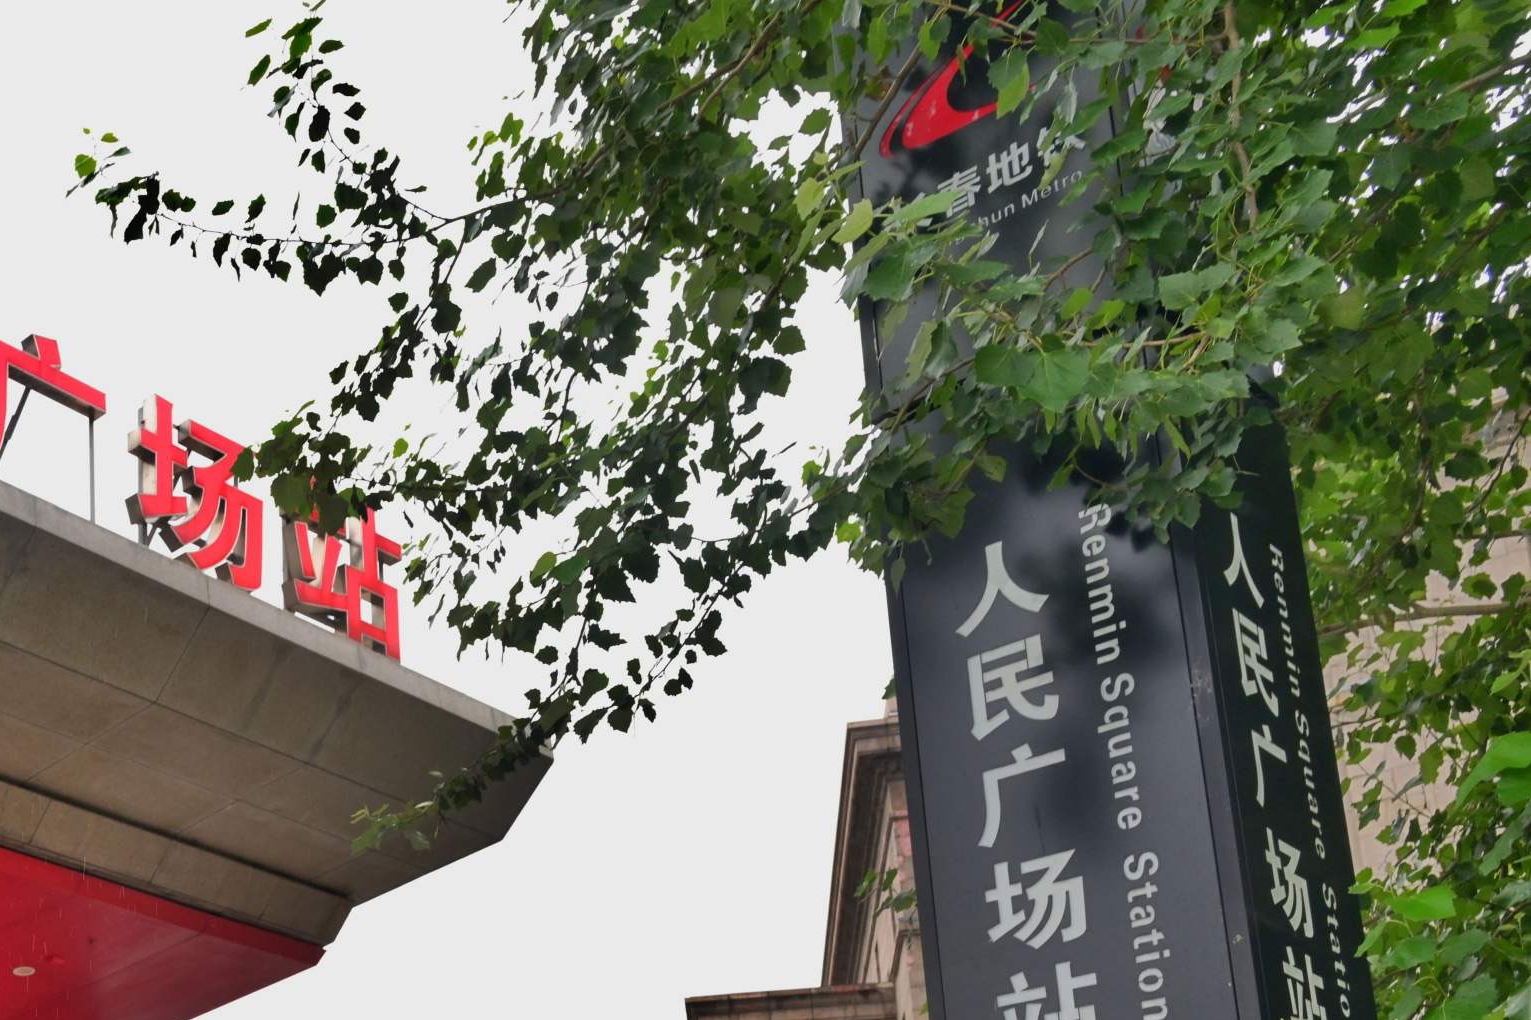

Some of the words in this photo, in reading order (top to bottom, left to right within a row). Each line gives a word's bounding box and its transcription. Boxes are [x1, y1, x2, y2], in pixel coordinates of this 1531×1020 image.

[1022, 168, 1082, 209] Metro
[1078, 503, 1127, 665] Renmin
[1097, 672, 1142, 830] Square
[1269, 543, 1302, 697] Renmin
[1295, 709, 1325, 860] Square
